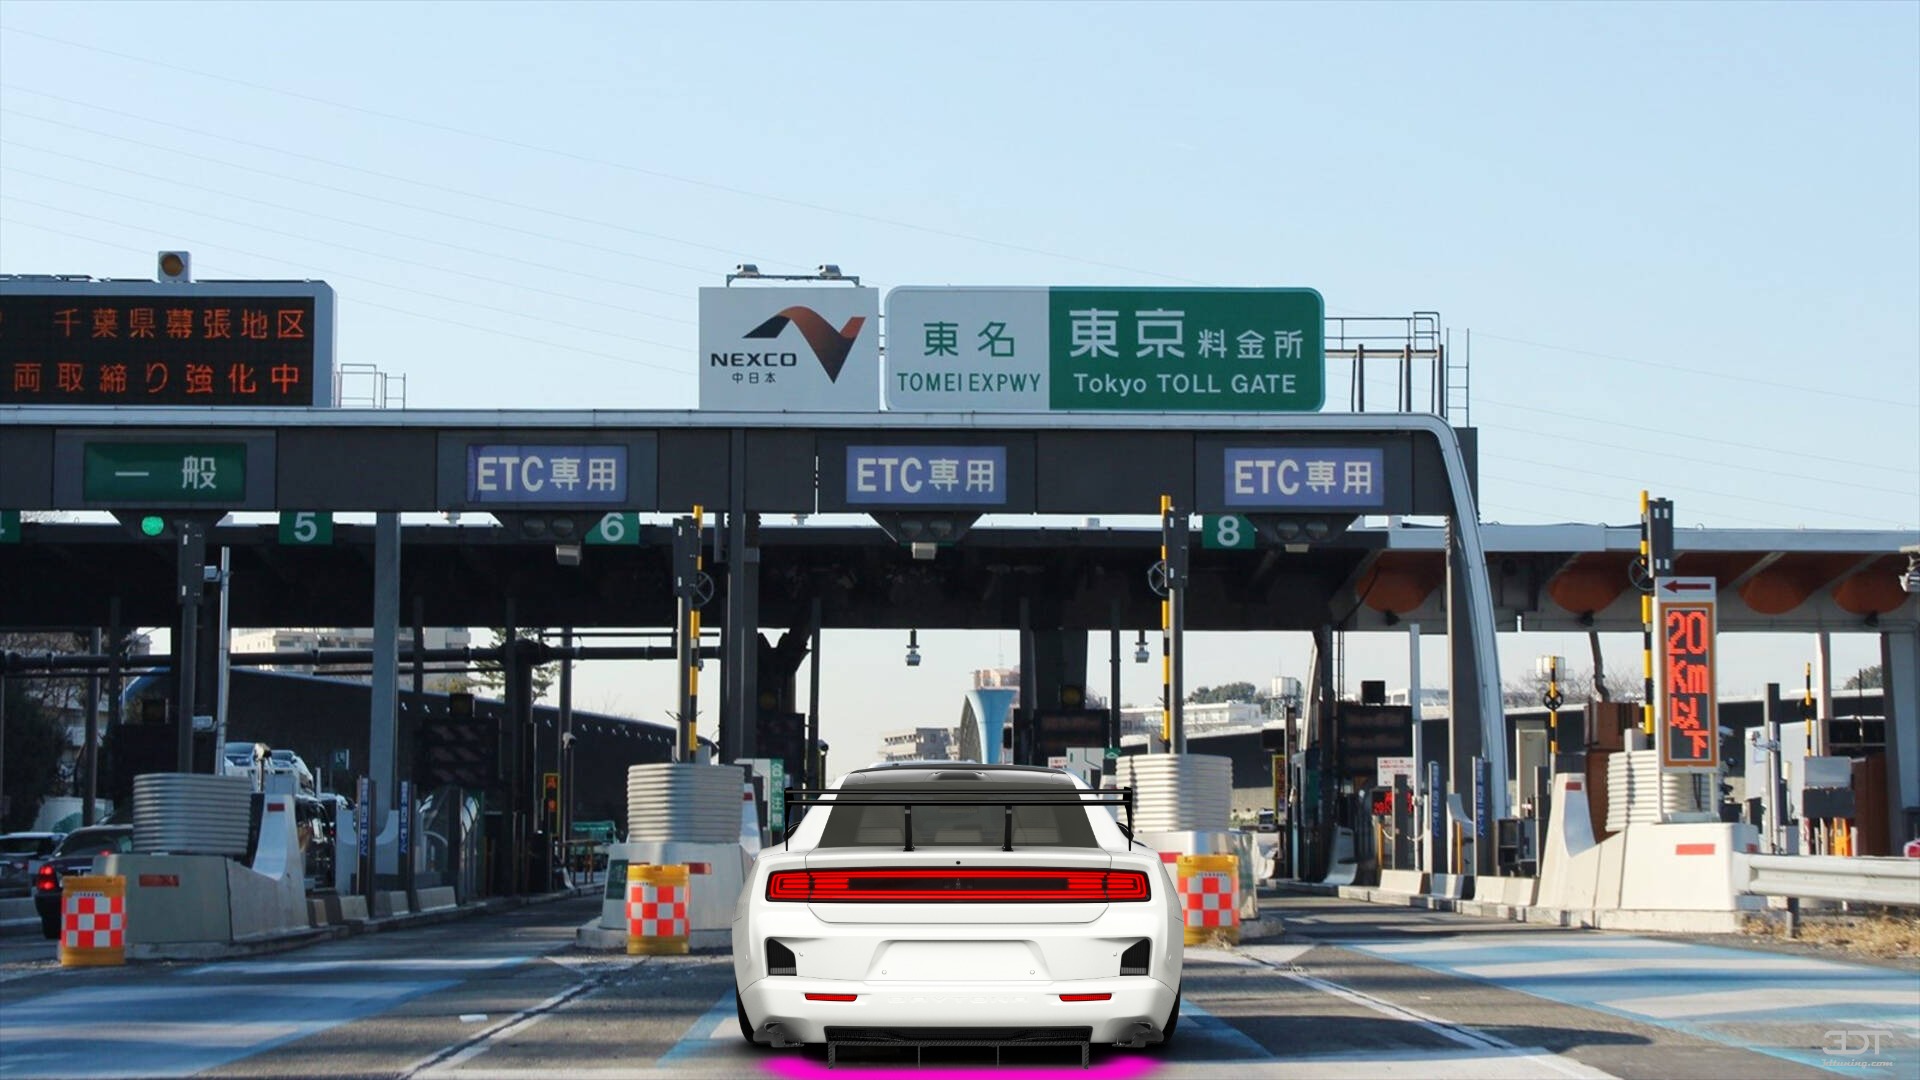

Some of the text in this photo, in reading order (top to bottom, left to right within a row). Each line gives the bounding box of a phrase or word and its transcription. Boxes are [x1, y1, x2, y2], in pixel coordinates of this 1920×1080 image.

[54, 308, 304, 339] 千葉県幕張地区
[923, 321, 1015, 357] 東名
[710, 352, 797, 367] NEXCO
[732, 371, 776, 384] 中日本
[897, 372, 1041, 392] TOMEI EXPWY
[1073, 373, 1297, 398] Tokyo TOLL GATE
[114, 455, 217, 490] 一般
[477, 456, 617, 493] ETC専用
[856, 457, 995, 494] ETC専用
[1234, 459, 1372, 496] ETC専用
[293, 512, 318, 543] 5
[600, 512, 625, 542] 6
[1216, 515, 1241, 547] 8
[1667, 611, 1709, 655] 20
